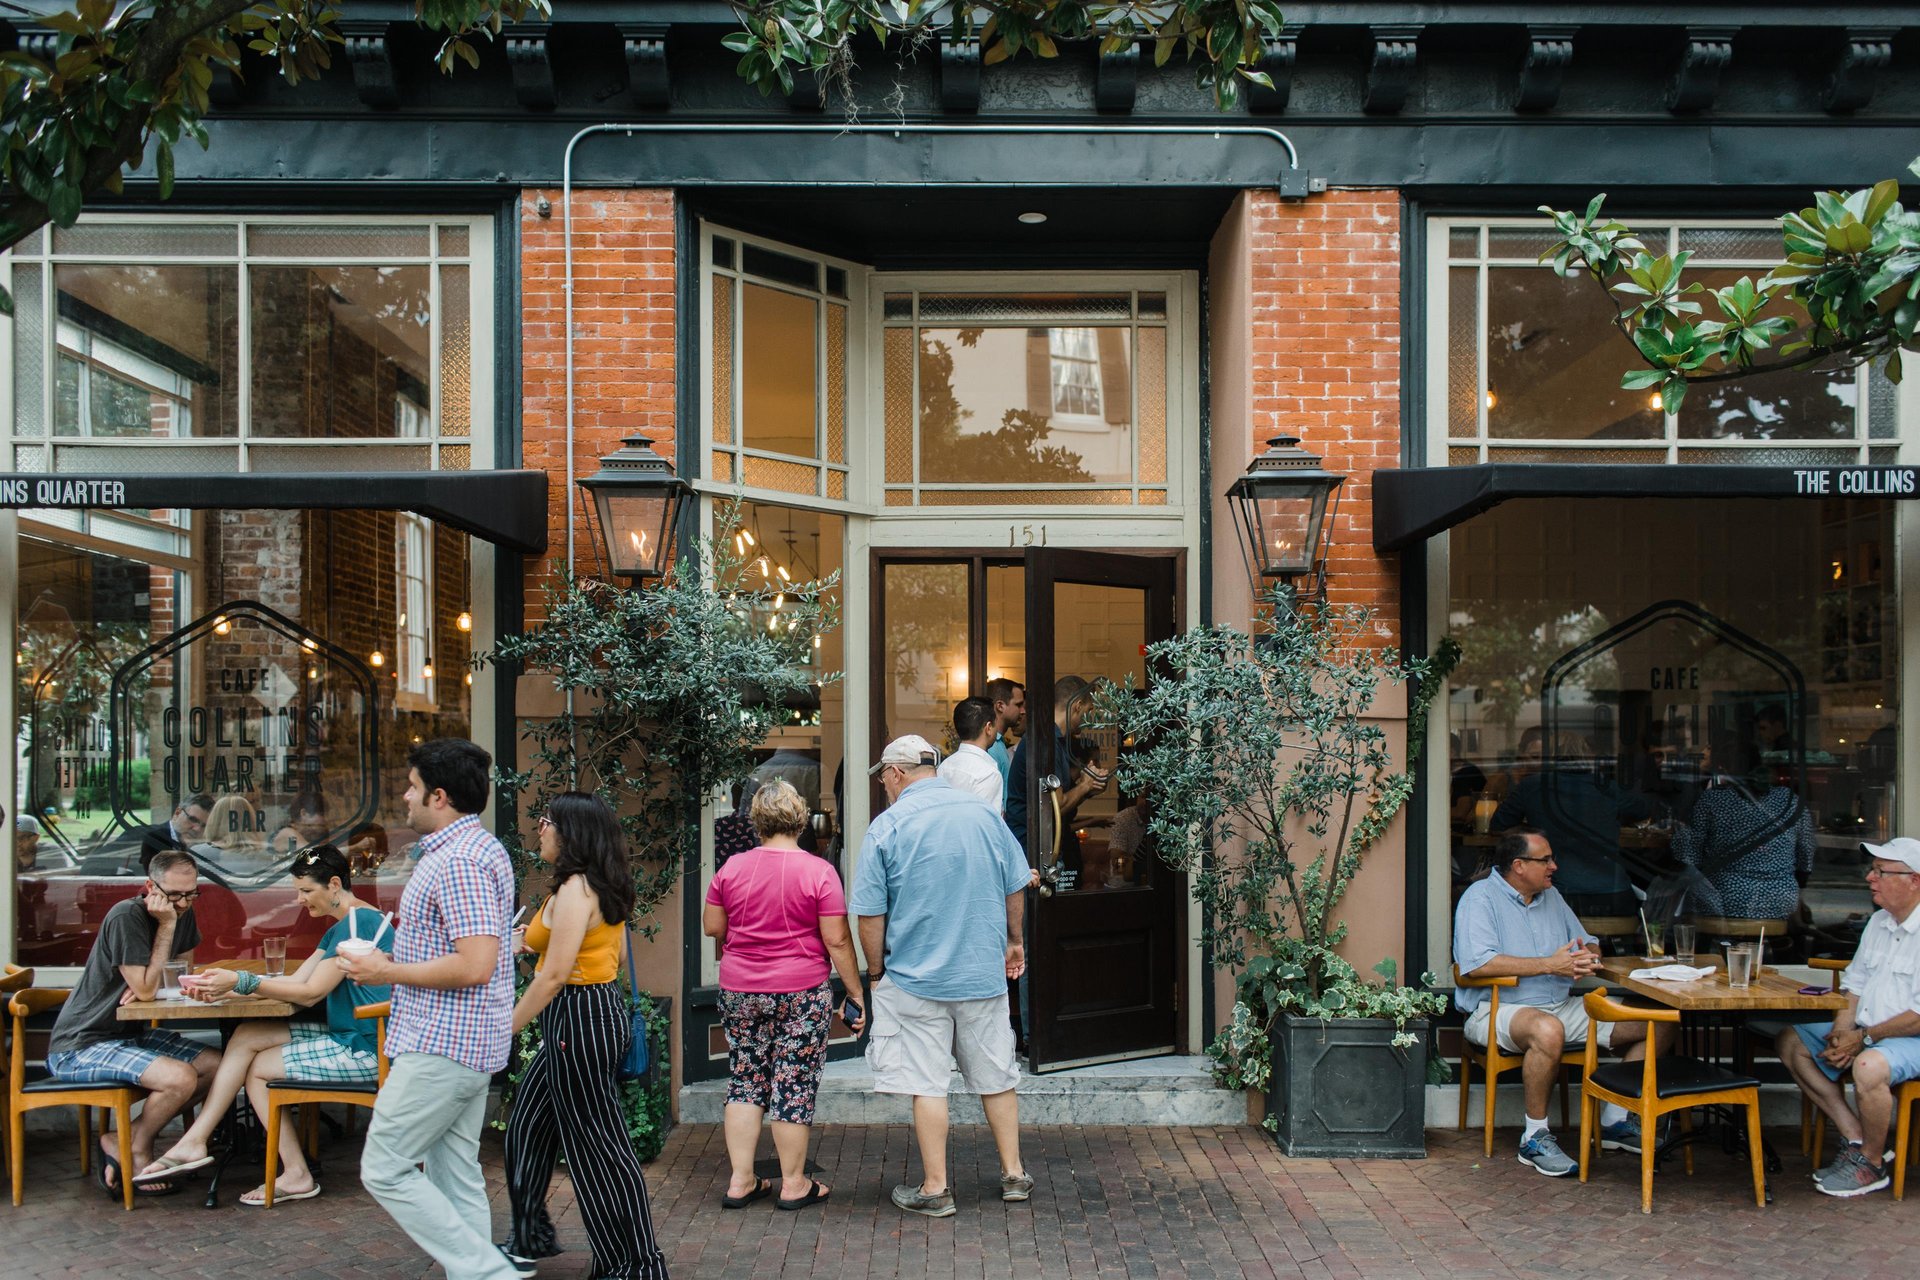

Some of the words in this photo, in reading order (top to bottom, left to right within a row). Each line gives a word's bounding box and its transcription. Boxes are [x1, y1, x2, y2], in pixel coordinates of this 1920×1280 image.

[36, 480, 125, 505] QUARTER
[1793, 470, 1830, 494] THE
[1839, 469, 1915, 494] COLLINS
[1009, 524, 1047, 548] 151
[221, 668, 270, 692] CAFE
[1650, 667, 1699, 690] CAFE
[163, 706, 324, 748] COLLINS
[163, 755, 324, 794] QUARTER
[228, 810, 267, 833] BAR
